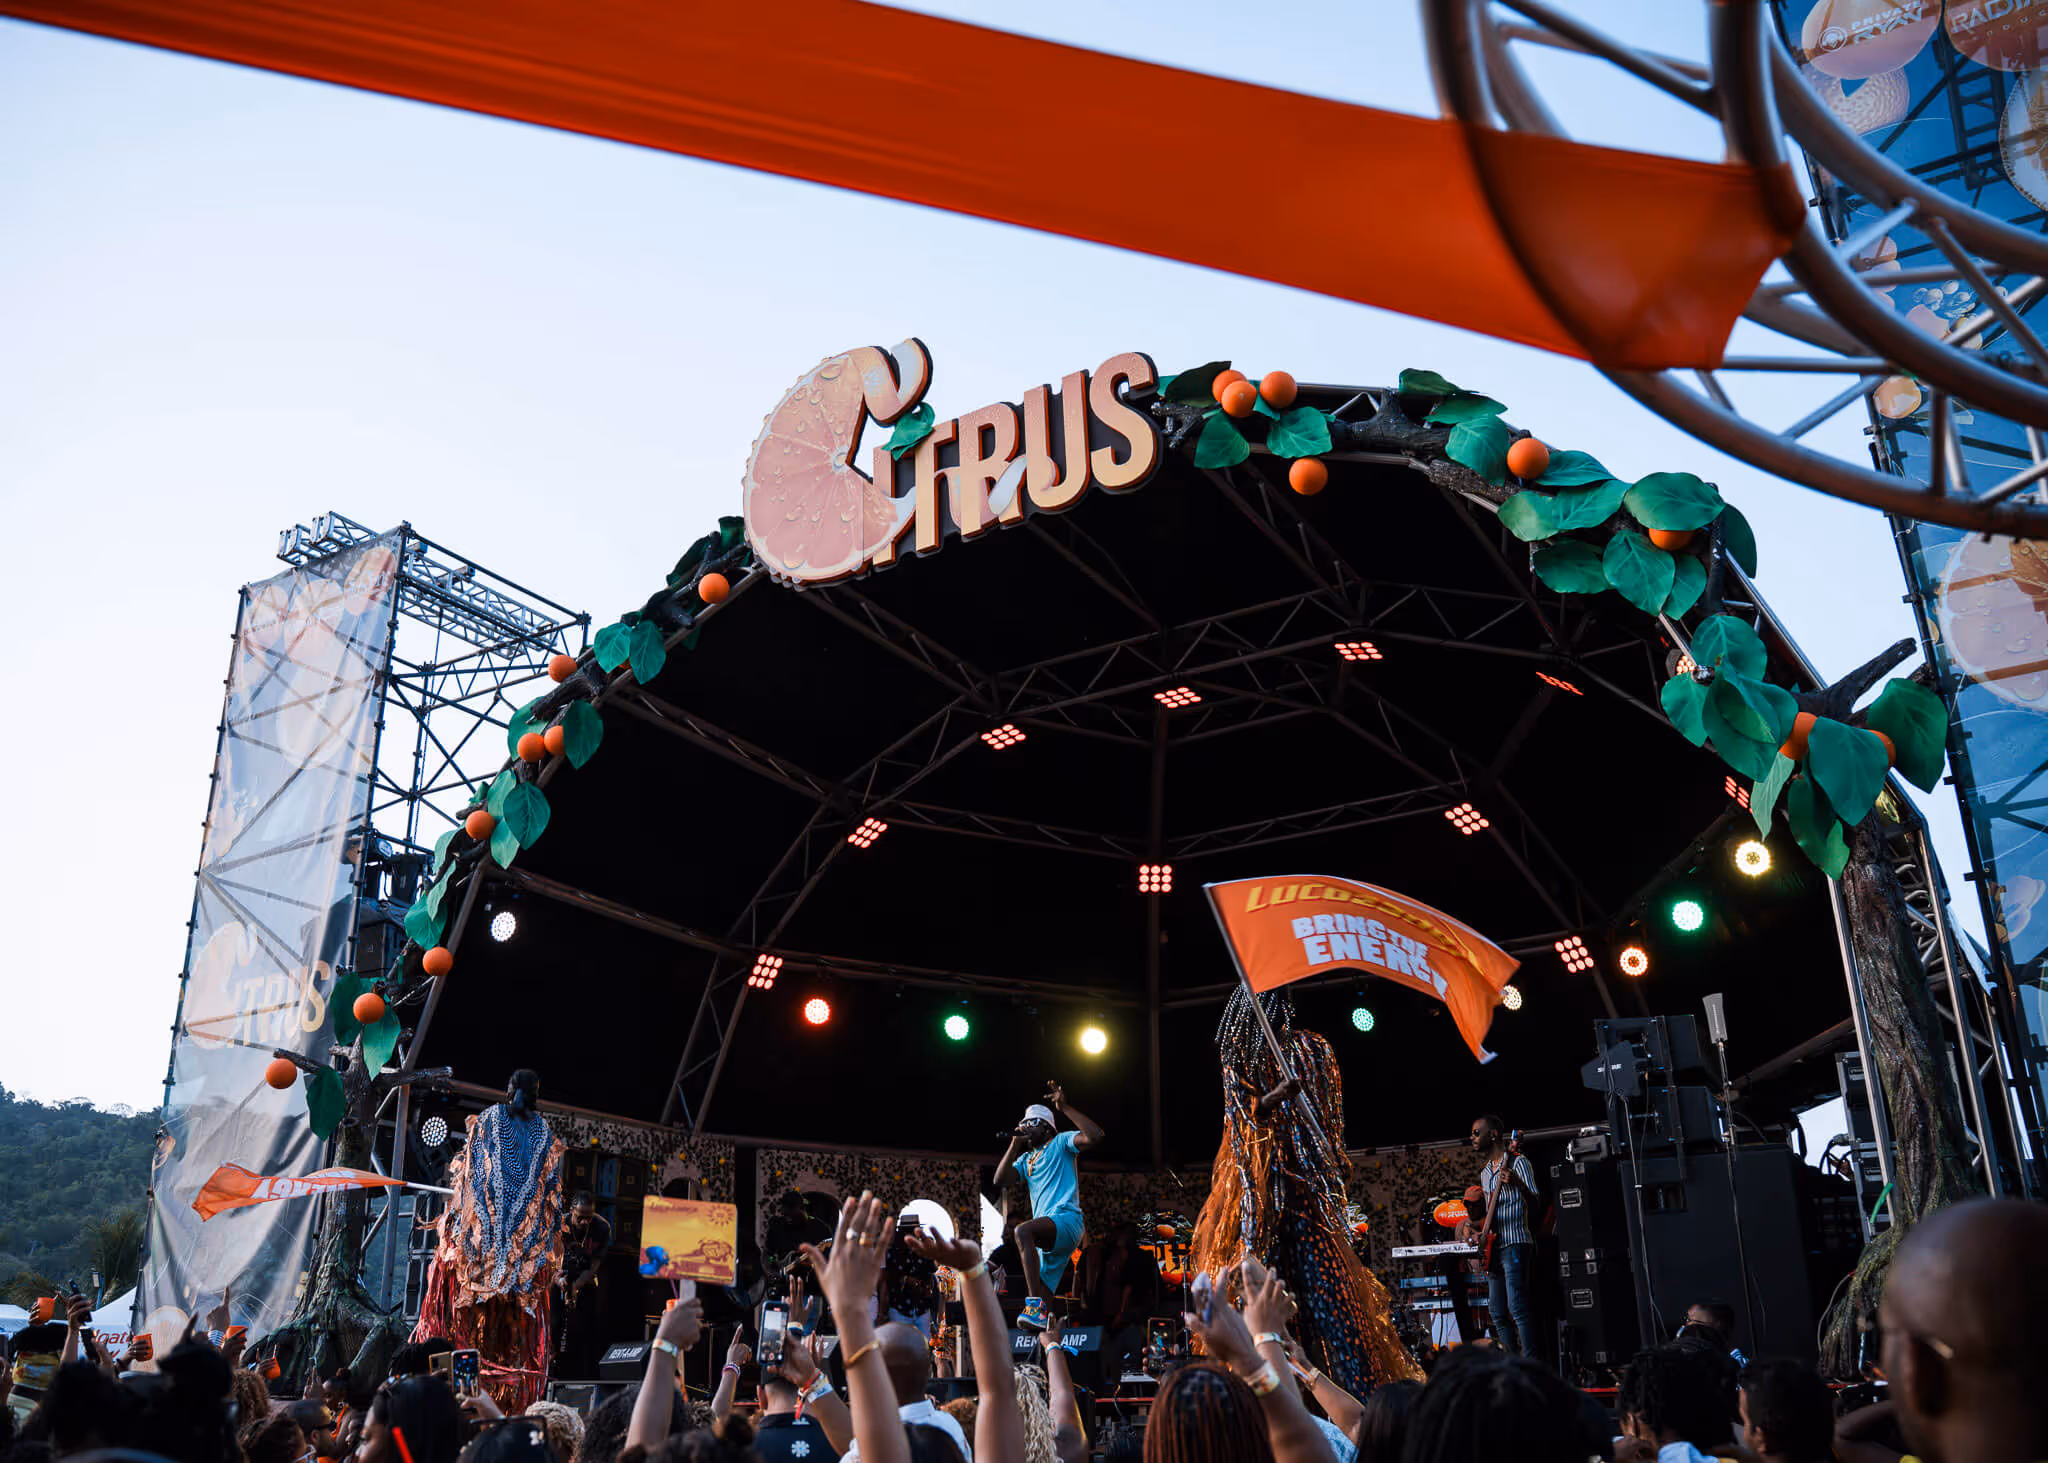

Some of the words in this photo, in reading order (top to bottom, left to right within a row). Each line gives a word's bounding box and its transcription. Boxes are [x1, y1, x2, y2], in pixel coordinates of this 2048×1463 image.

[743, 337, 1159, 590] CITRUS
[1291, 913, 1387, 940] BRING
[1302, 933, 1448, 1001] ENERGY
